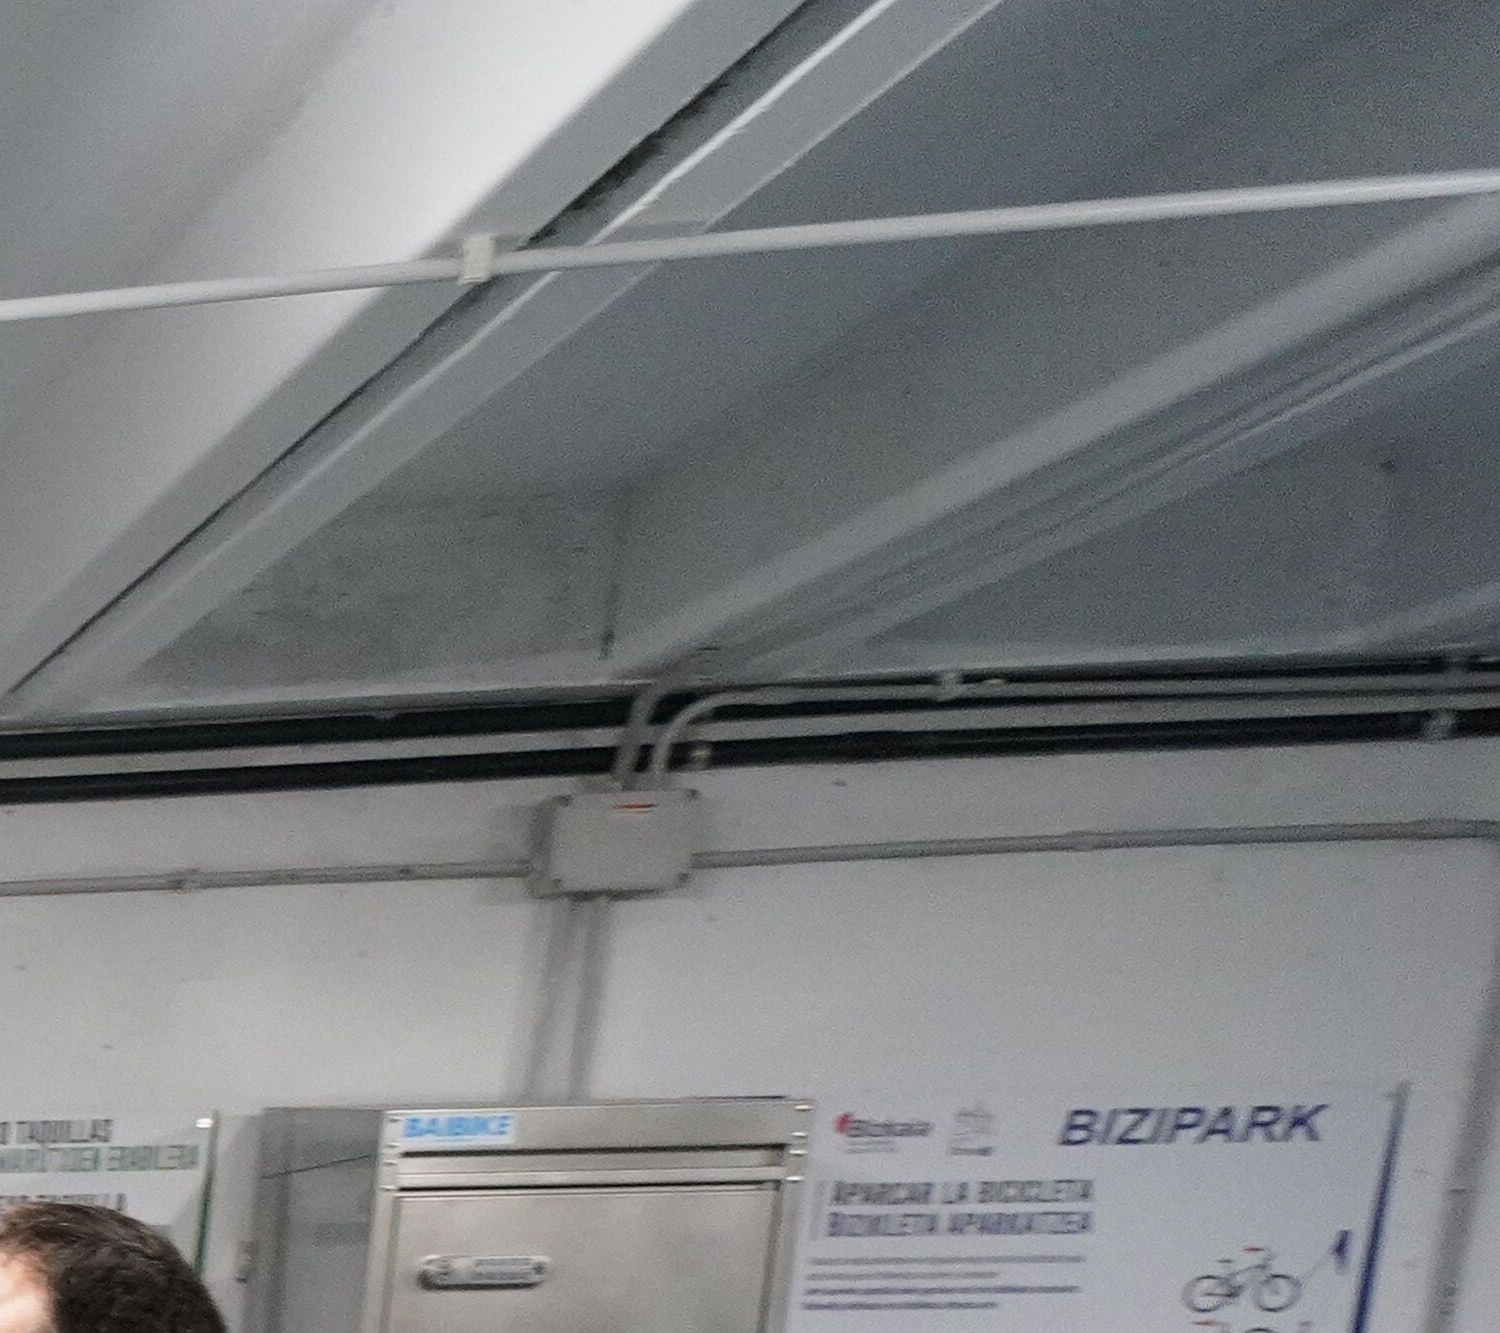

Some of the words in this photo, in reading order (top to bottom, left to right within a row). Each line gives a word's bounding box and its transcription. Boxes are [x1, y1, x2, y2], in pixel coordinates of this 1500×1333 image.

[404, 1115, 514, 1138] BAIBIKE
[1057, 1104, 1329, 1145] BIZIPARK
[978, 1180, 1093, 1203] BICICLETA
